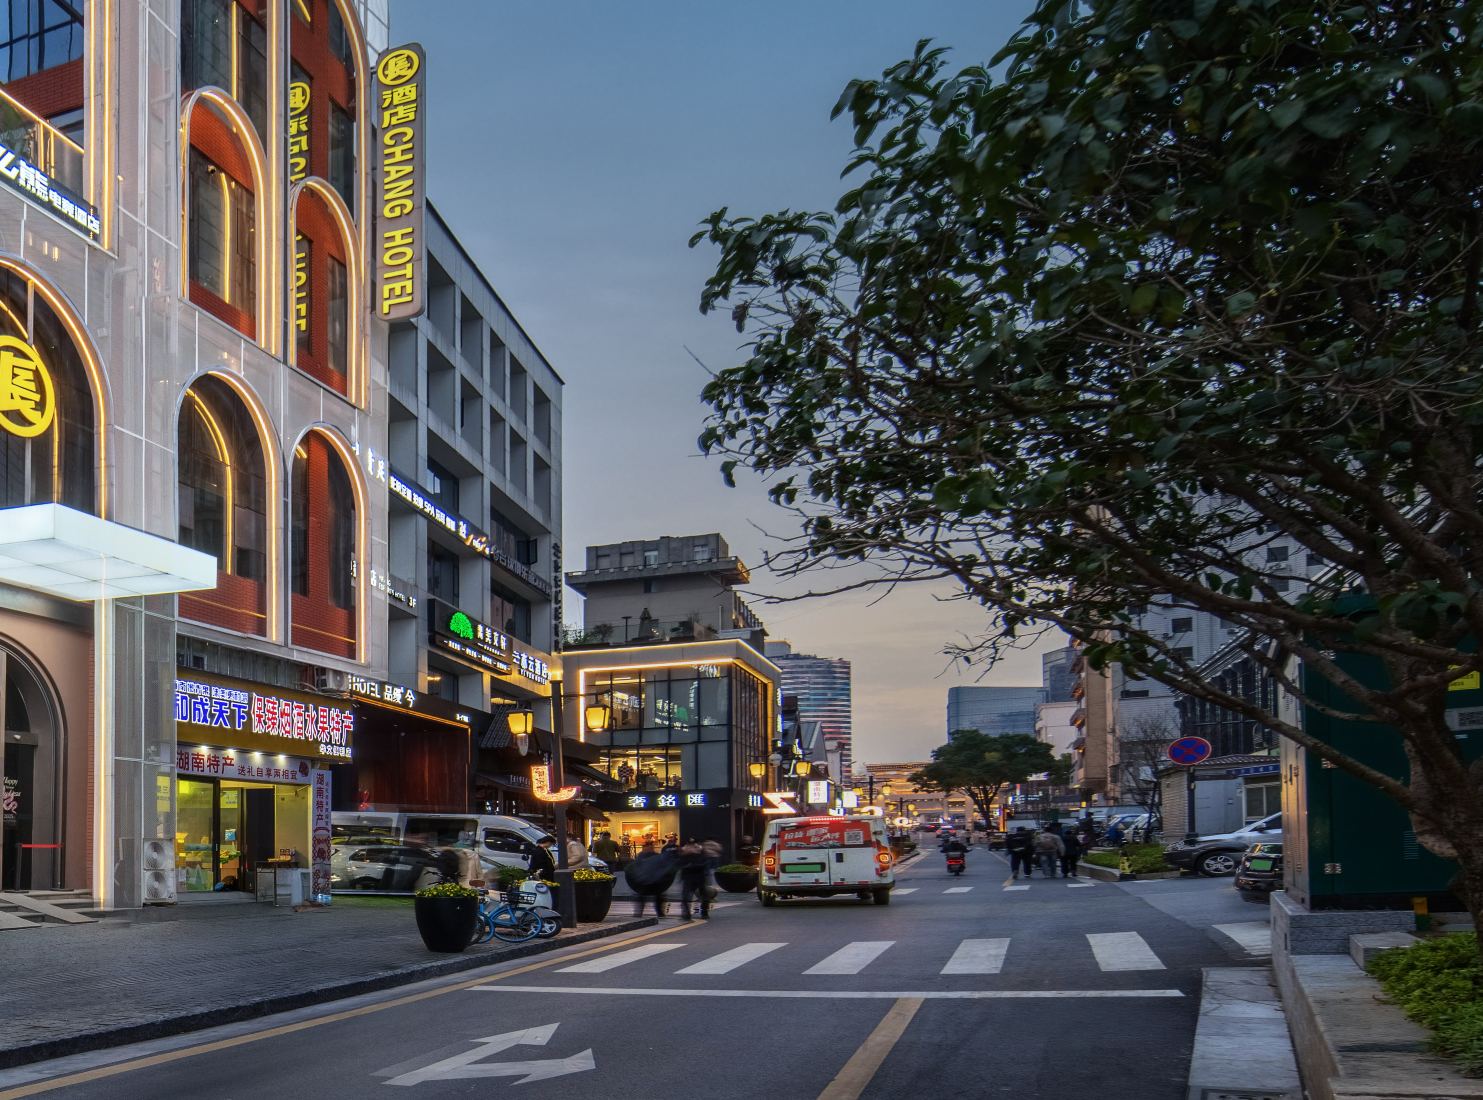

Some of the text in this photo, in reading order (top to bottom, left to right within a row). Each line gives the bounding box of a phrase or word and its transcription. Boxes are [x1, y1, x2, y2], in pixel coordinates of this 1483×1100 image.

[382, 82, 417, 129] 酒店
[382, 129, 415, 314] CHANG HOTEL
[423, 501, 435, 517] SPA
[177, 750, 236, 777] 湖南特产
